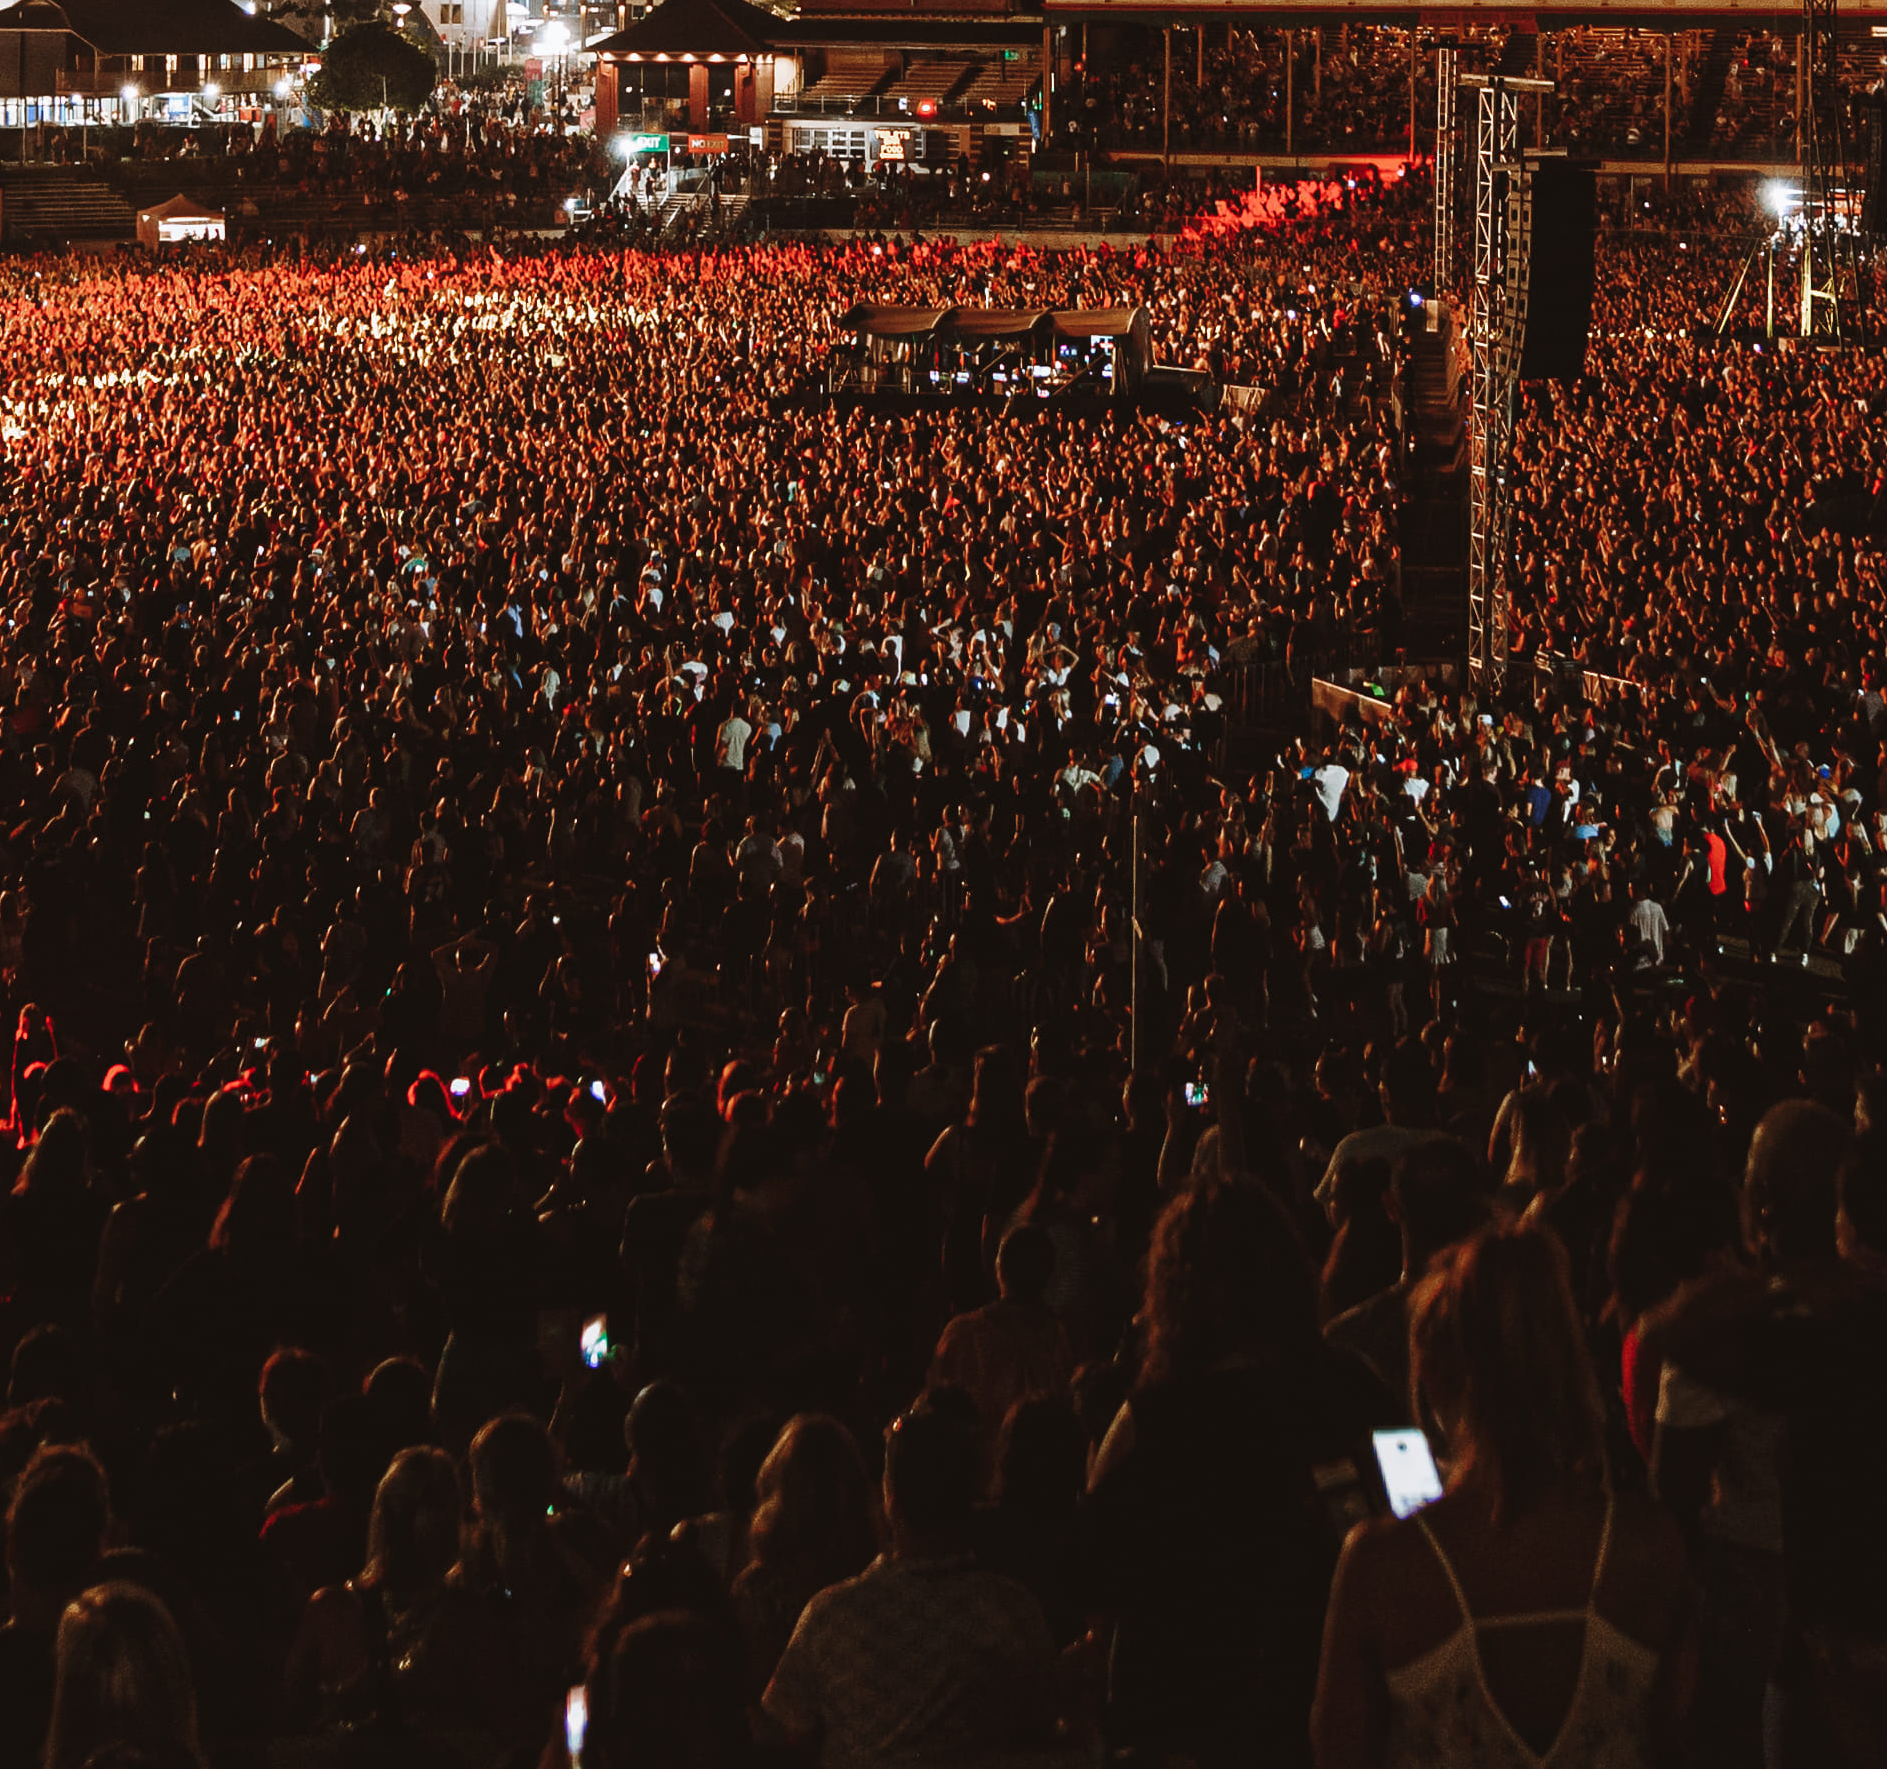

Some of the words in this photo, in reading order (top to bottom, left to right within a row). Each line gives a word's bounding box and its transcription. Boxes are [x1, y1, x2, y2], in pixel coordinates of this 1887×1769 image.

[637, 136, 661, 148] EXIT
[691, 139, 705, 148] NO
[707, 140, 725, 149] EXIT
